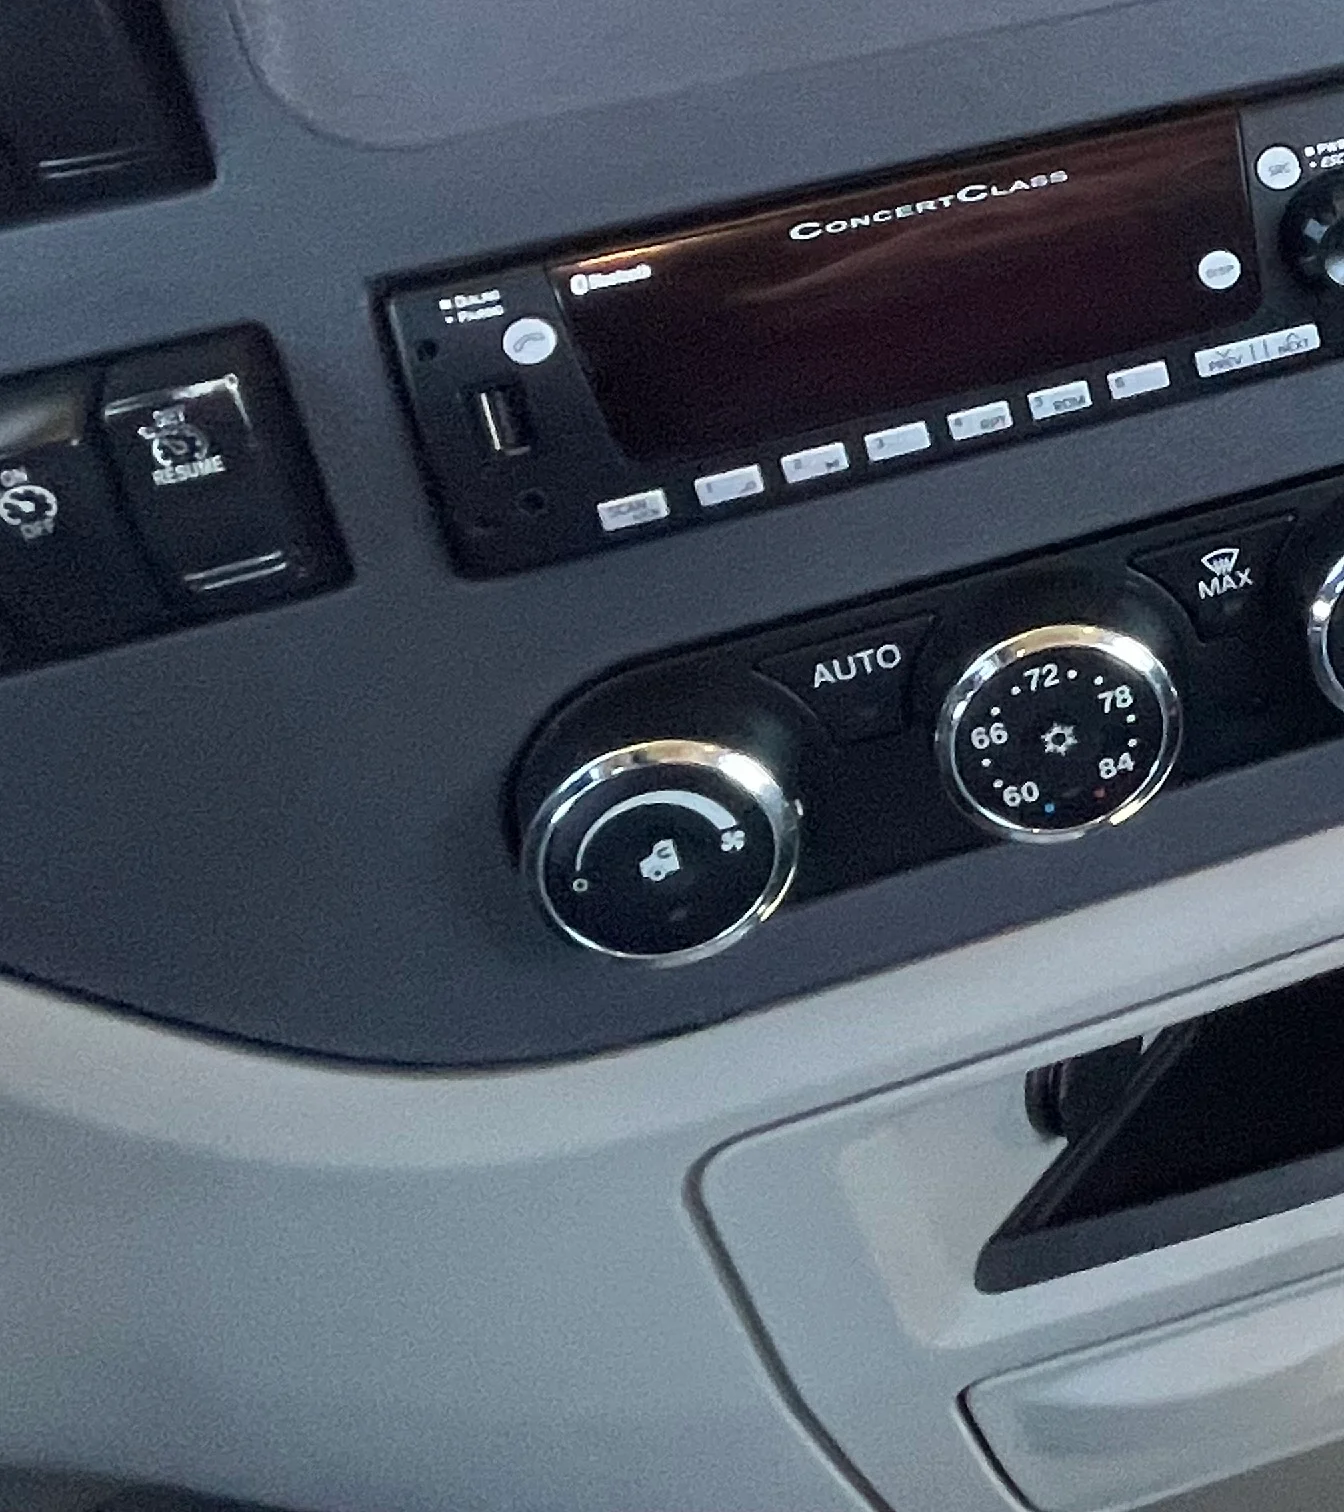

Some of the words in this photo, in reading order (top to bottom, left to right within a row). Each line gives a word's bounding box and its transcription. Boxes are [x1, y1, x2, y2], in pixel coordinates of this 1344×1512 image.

[152, 455, 227, 486] RESUME
[1198, 567, 1254, 600] MAX
[814, 644, 902, 688] AUTO
[1023, 663, 1060, 692] 72
[1097, 684, 1134, 714] 78
[970, 722, 1009, 750] 66
[1098, 752, 1136, 780] 84
[1002, 780, 1040, 808] 60
